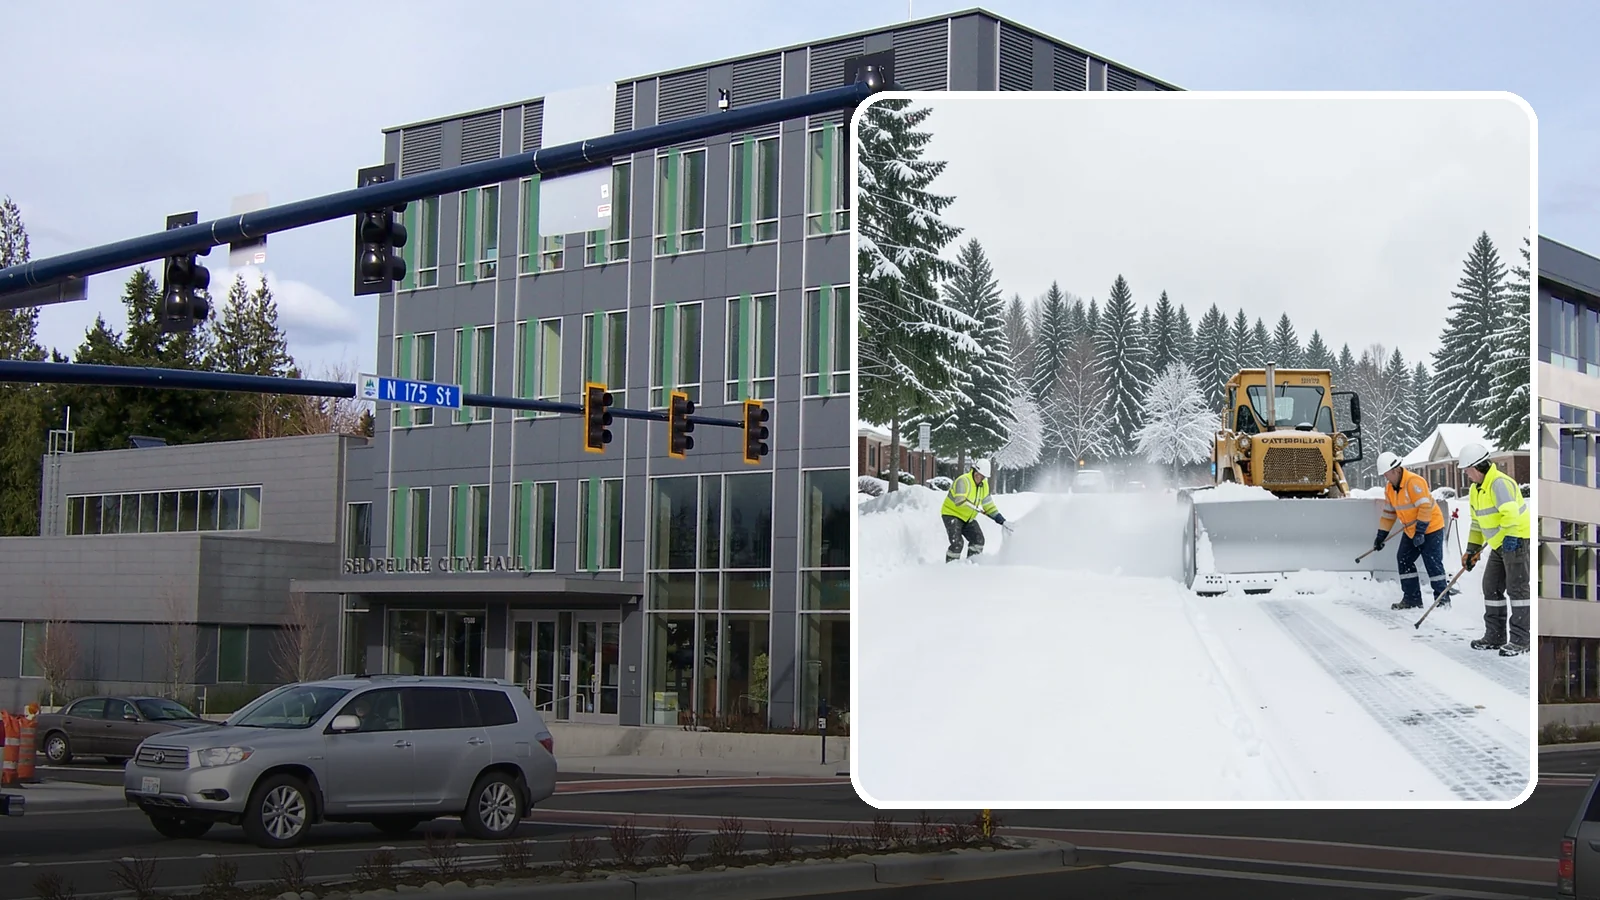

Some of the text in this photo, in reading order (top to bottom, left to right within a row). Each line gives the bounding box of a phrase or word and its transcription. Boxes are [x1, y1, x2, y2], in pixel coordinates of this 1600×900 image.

[387, 380, 451, 406] N 175 St
[344, 555, 526, 573] SHORELINE CITY HALL
